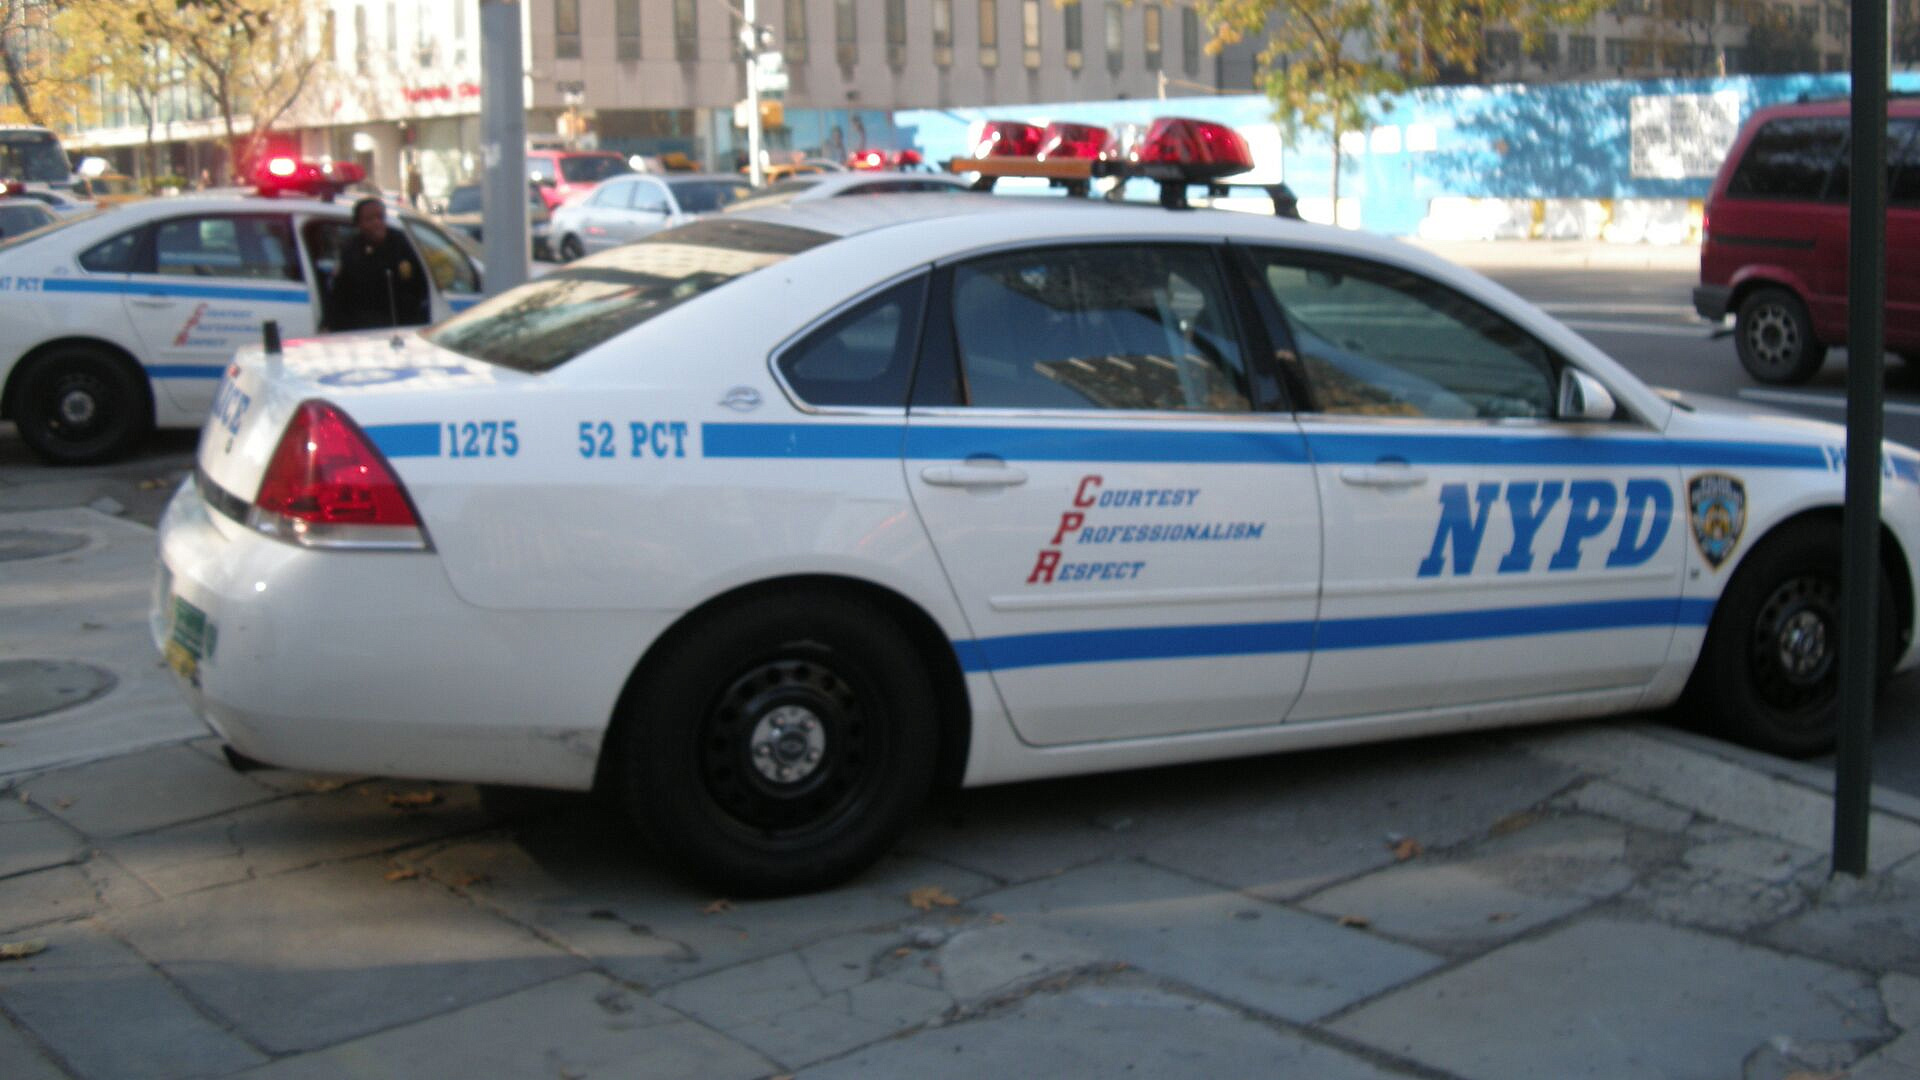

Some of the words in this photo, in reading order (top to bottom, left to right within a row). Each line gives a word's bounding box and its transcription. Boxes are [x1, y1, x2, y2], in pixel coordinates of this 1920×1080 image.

[447, 420, 519, 458] 1275
[578, 421, 615, 459] 52
[629, 421, 688, 458] PCT
[1073, 474, 1200, 508] COURTESY
[1050, 511, 1265, 545] PROFESSIONALISM
[1416, 478, 1674, 578] NYPD
[1026, 549, 1146, 584] RESPECT
